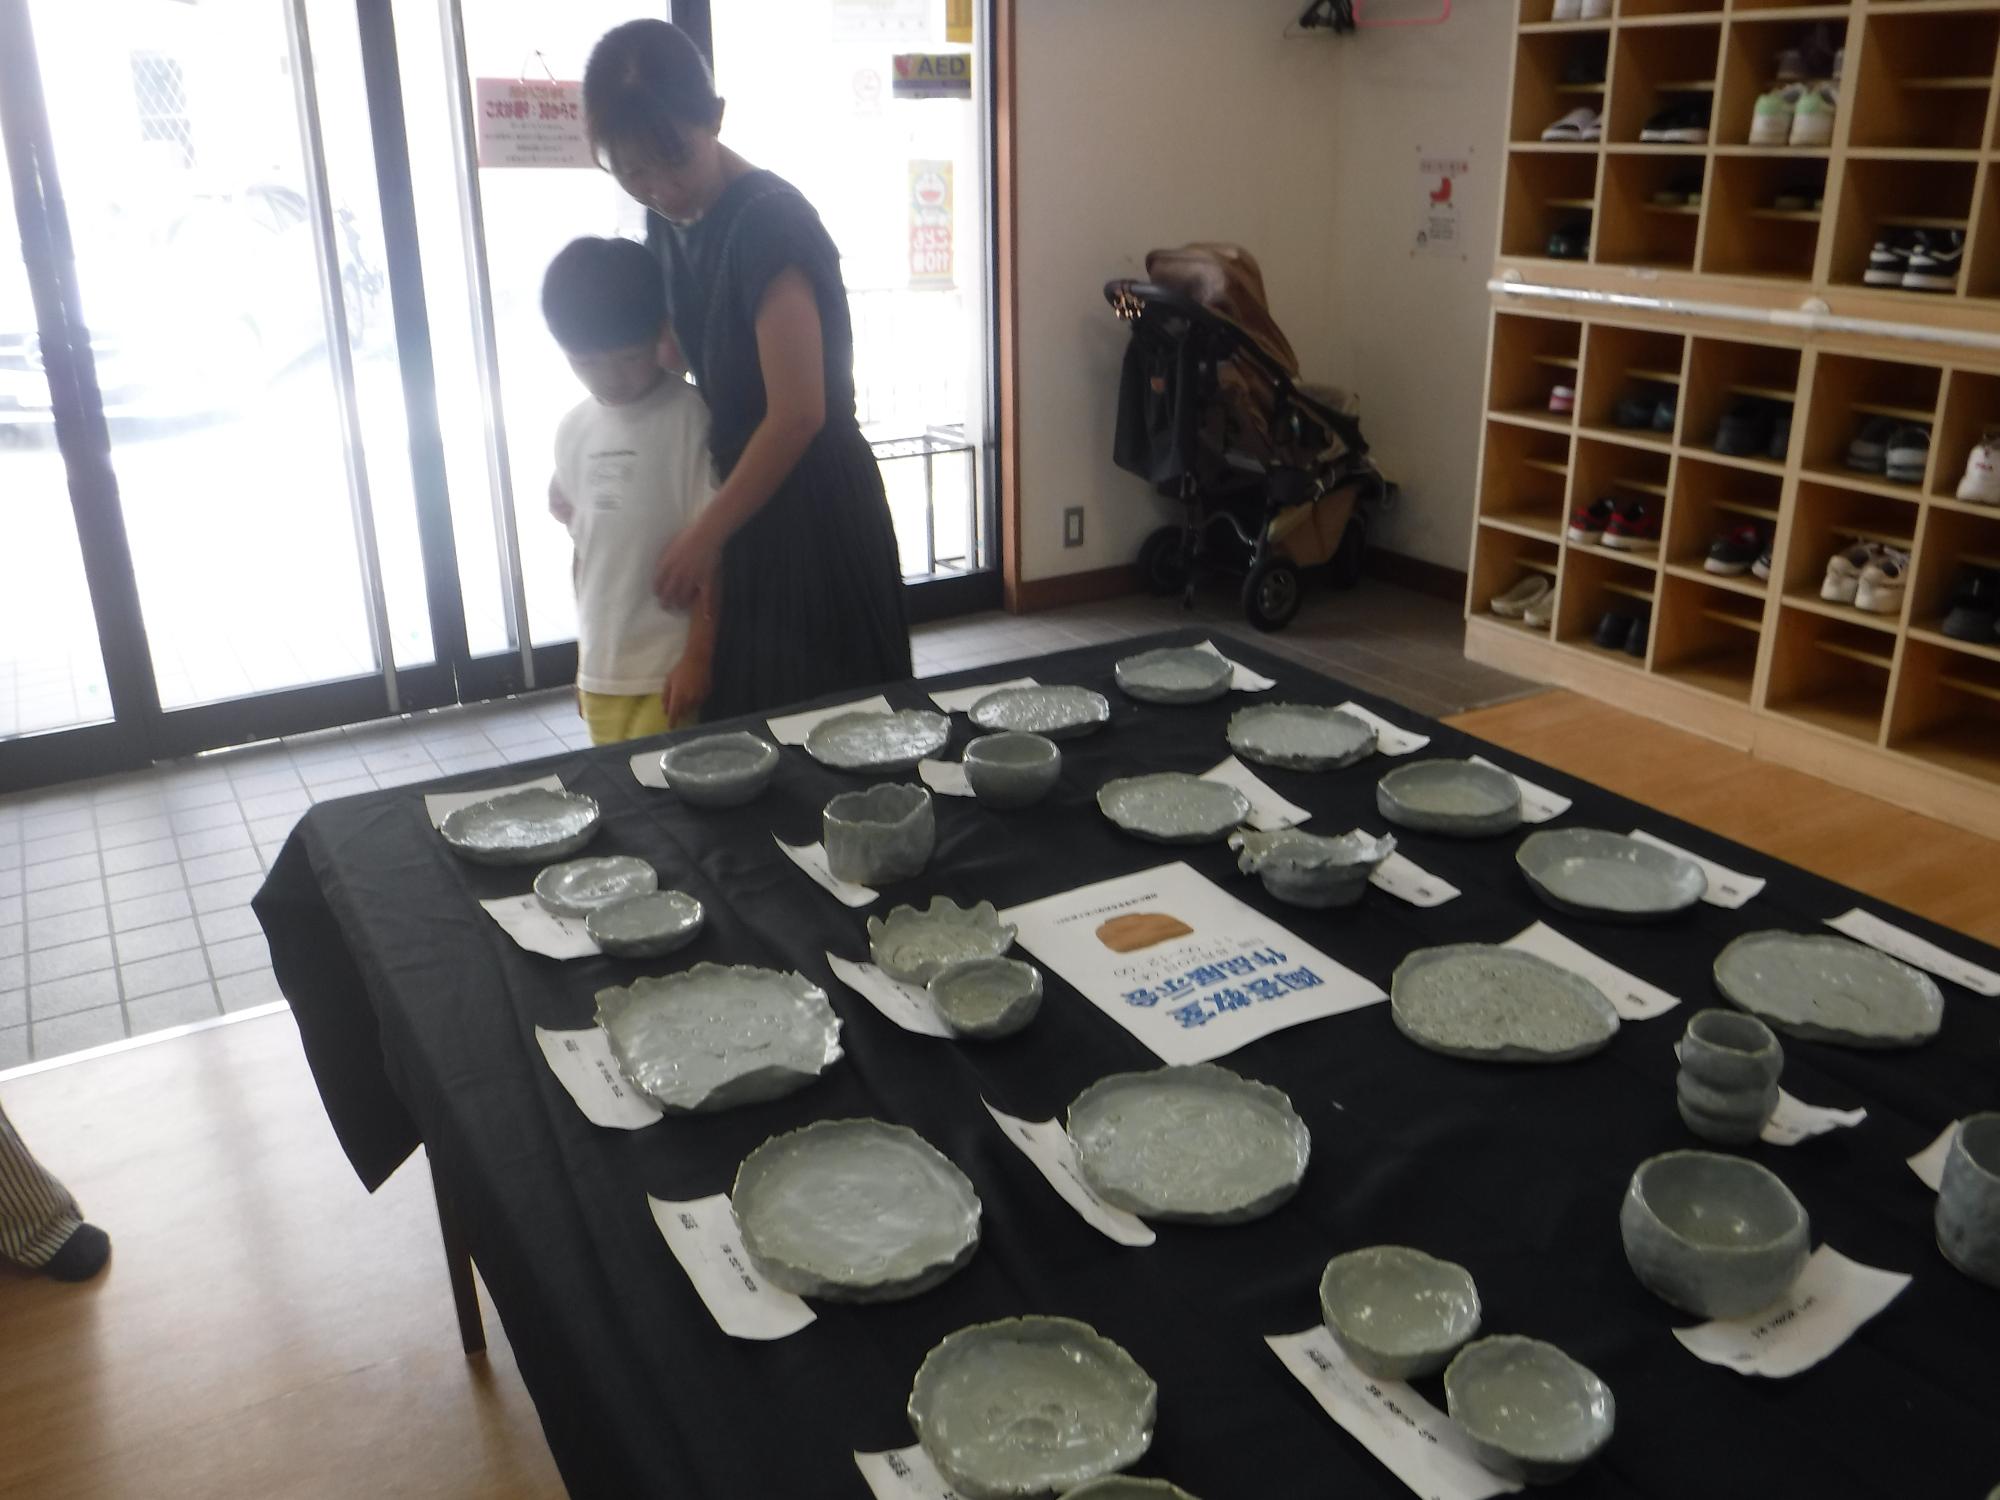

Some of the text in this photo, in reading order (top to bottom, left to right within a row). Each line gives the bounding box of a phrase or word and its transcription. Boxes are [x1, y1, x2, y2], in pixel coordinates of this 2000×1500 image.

[917, 56, 966, 76] AED
[1121, 947, 1288, 1008] 作品展示会
[1165, 965, 1326, 1029] 陶芸教室
